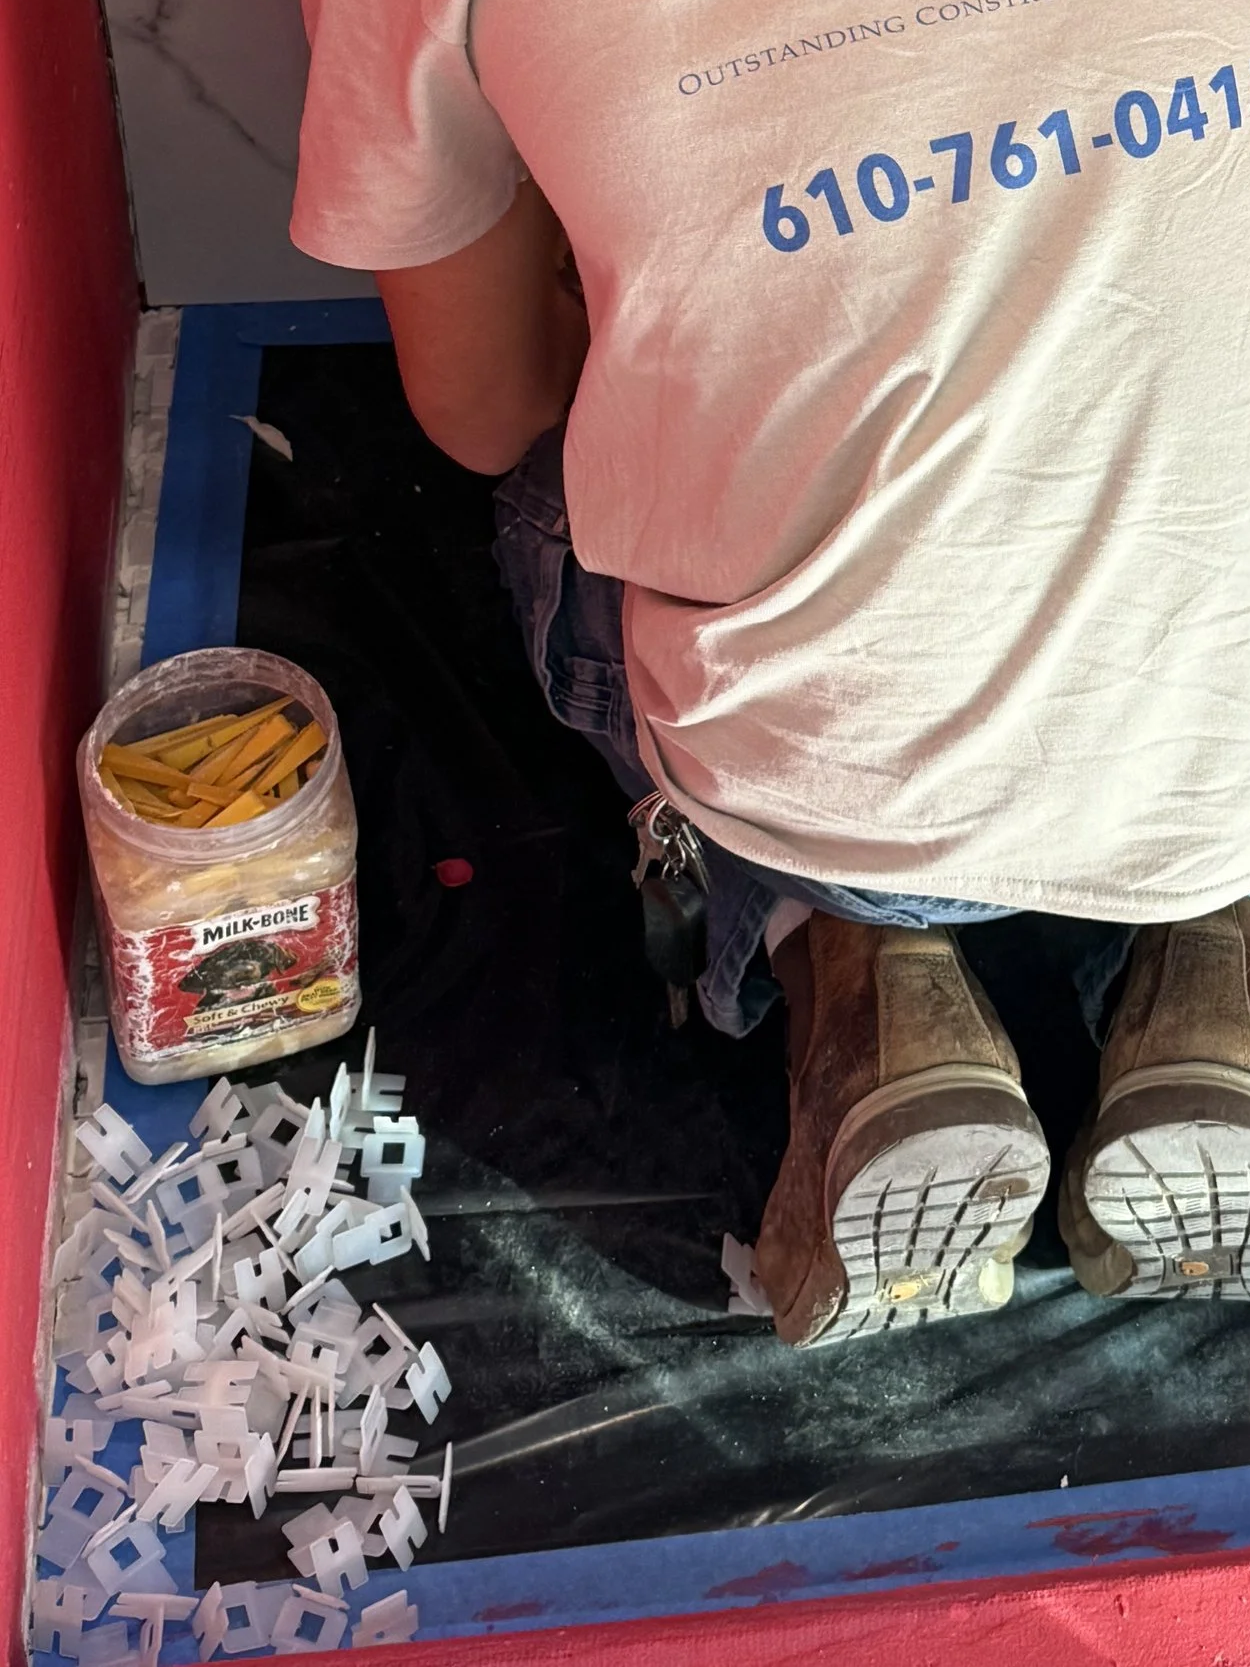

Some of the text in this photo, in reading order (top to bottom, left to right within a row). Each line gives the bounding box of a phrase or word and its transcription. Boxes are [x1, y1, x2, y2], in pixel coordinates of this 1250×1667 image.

[202, 903, 310, 946] MILK-BONE
[193, 1011, 224, 1025] Soft
[227, 1008, 238, 1017] &
[240, 995, 289, 1014] Chewy
